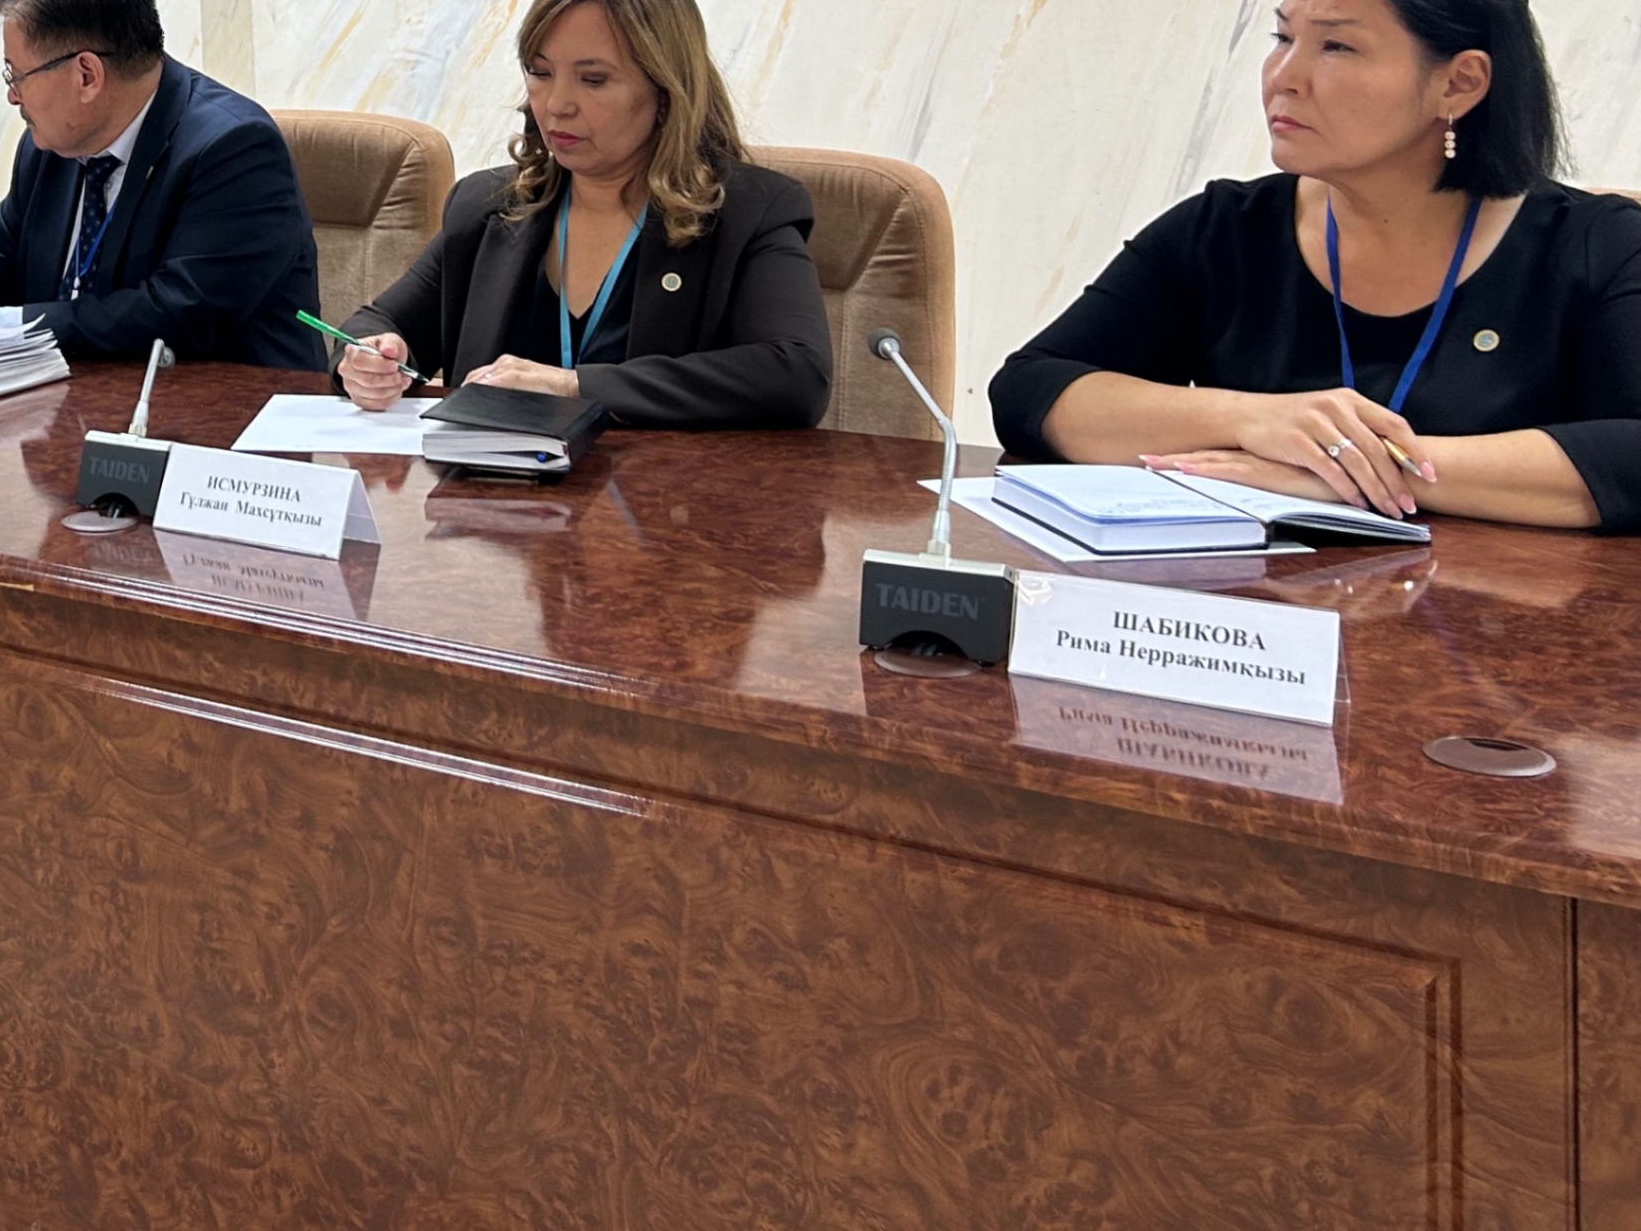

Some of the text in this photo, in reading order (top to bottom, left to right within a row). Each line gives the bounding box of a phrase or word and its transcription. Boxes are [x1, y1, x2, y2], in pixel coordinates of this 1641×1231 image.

[89, 457, 150, 483] TAIDEN
[207, 475, 301, 503] ИСМУРЗИНА
[876, 583, 979, 620] TAIDEN
[1112, 610, 1267, 652] ШАБИКОВА
[1056, 629, 1306, 685] Рима Нерражимқызы
